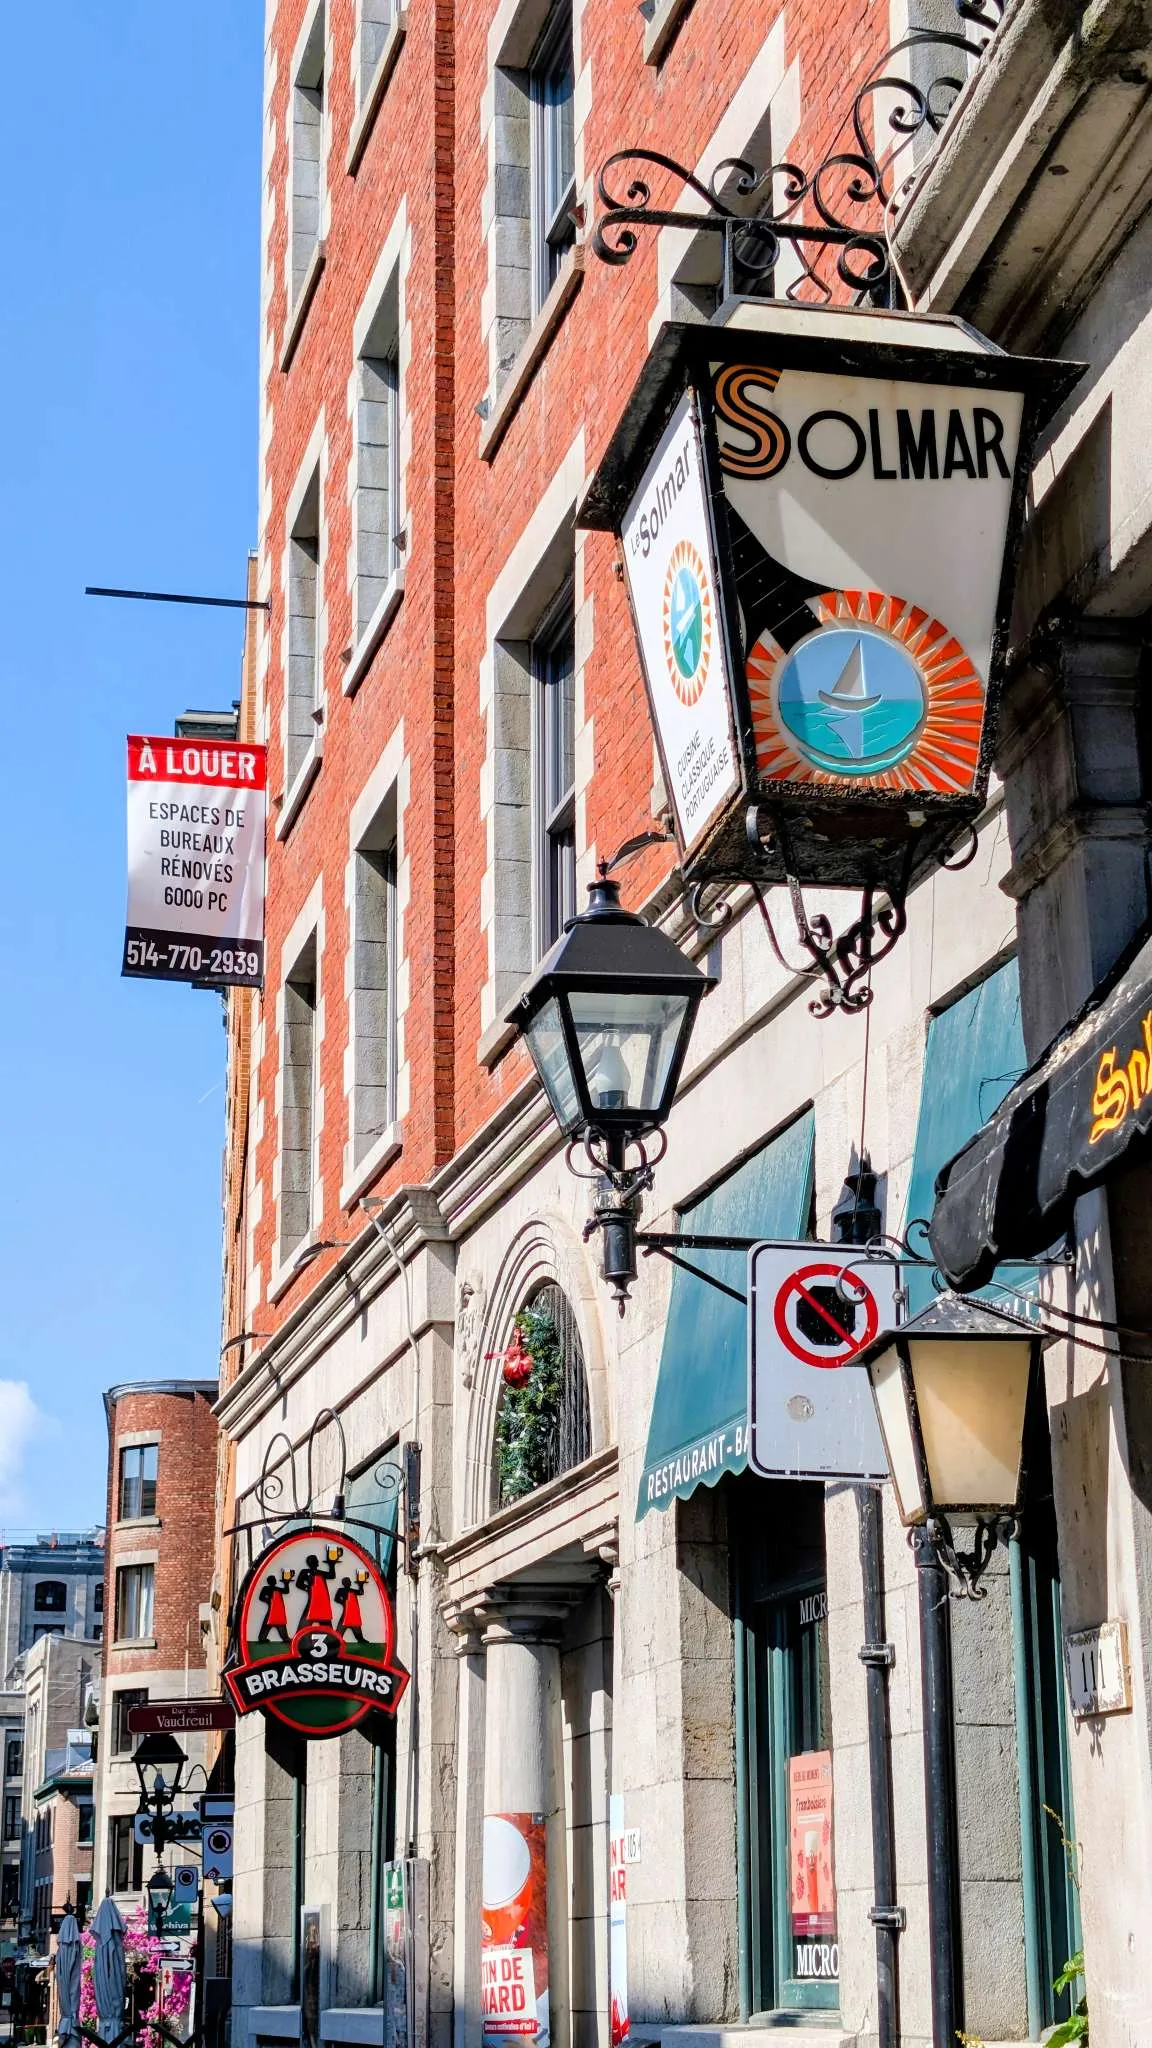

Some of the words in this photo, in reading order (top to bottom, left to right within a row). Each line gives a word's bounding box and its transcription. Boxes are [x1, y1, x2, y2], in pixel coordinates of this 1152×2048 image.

[711, 361, 1011, 481] SOLMAR
[630, 532, 640, 556] Le
[640, 439, 690, 558] Solmar
[138, 737, 157, 773] À
[166, 746, 256, 781] LOUER
[677, 729, 701, 778] CUISINE
[681, 736, 716, 800] CLASSIQUE
[685, 746, 729, 823] PORTUGUAISE
[149, 802, 220, 826] ESPACES
[225, 809, 245, 828] DE
[160, 829, 234, 854] BUREAUX
[161, 854, 233, 883] RÉNOVÉS
[164, 886, 203, 910] 6000
[208, 891, 227, 912] PC
[126, 940, 259, 976] 514-770-2939
[309, 1633, 328, 1658] 3
[245, 1663, 393, 1696] BRASSEURS
[1081, 1648, 1106, 1692] 111
[156, 1712, 213, 1728] Vaudreuil
[171, 1706, 185, 1714] Rue
[187, 1706, 196, 1714] de
[500, 1957, 524, 1982] DE
[796, 1943, 839, 1977] MICRO
